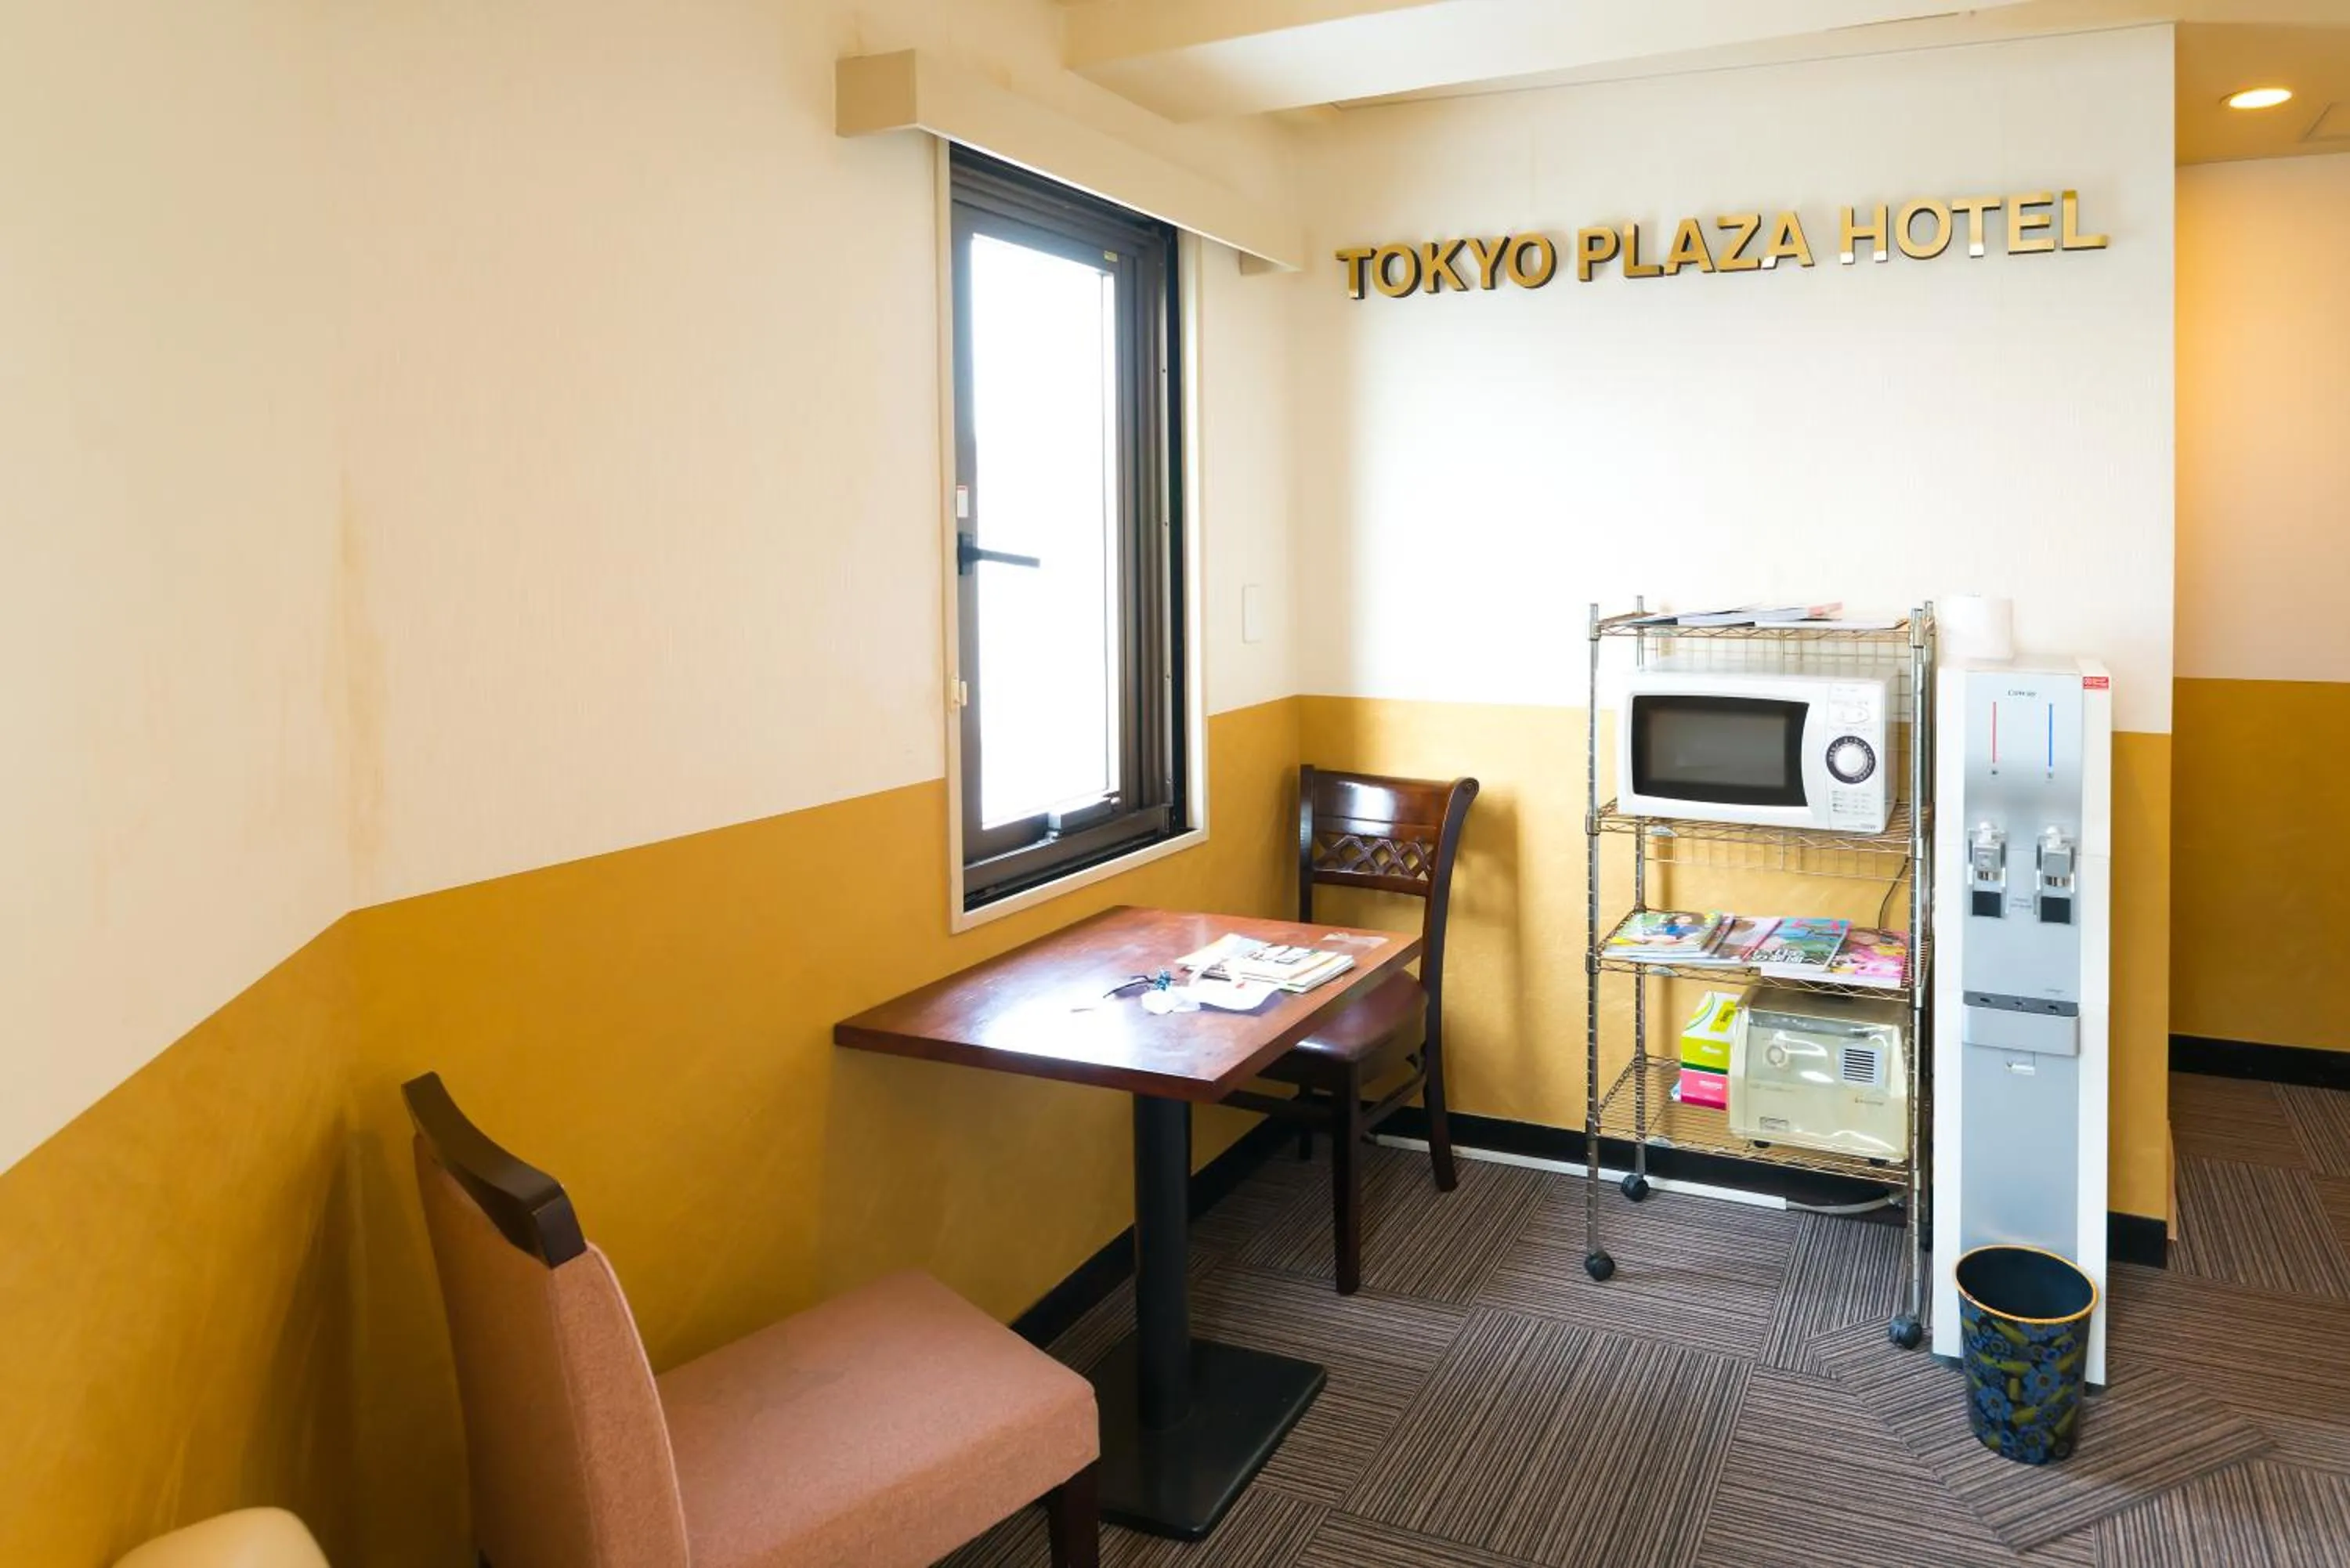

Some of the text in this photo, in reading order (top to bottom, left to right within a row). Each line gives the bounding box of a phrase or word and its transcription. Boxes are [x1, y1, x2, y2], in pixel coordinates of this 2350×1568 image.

[1335, 190, 2110, 299] TOKYO PLAZA HOTEL
